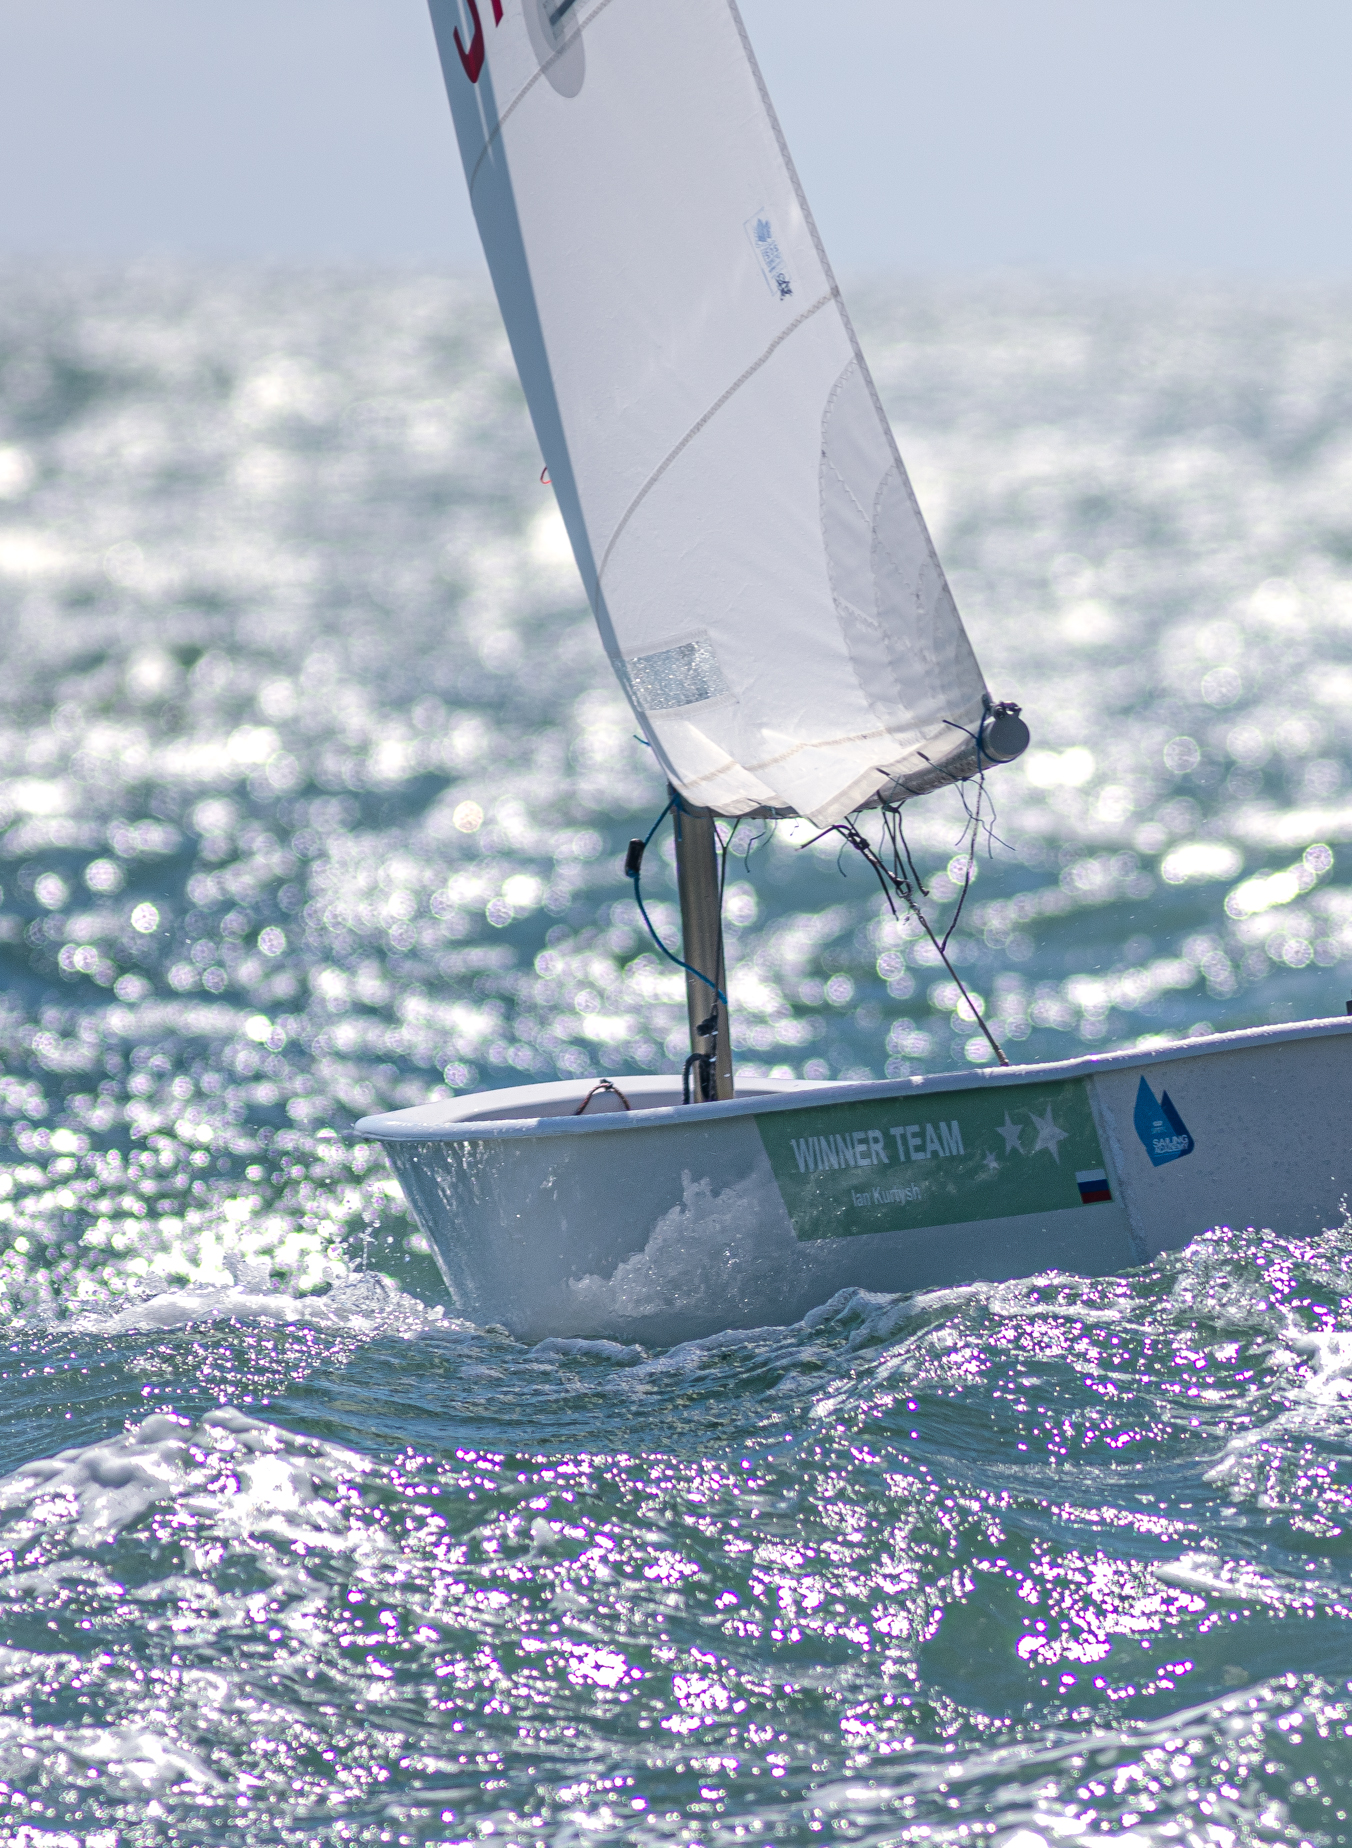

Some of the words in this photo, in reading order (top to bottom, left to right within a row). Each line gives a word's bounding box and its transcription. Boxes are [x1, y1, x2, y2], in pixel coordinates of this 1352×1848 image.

[790, 1128, 890, 1174] WINNER
[889, 1119, 966, 1163] TEAM
[1152, 1134, 1189, 1149] SAILING
